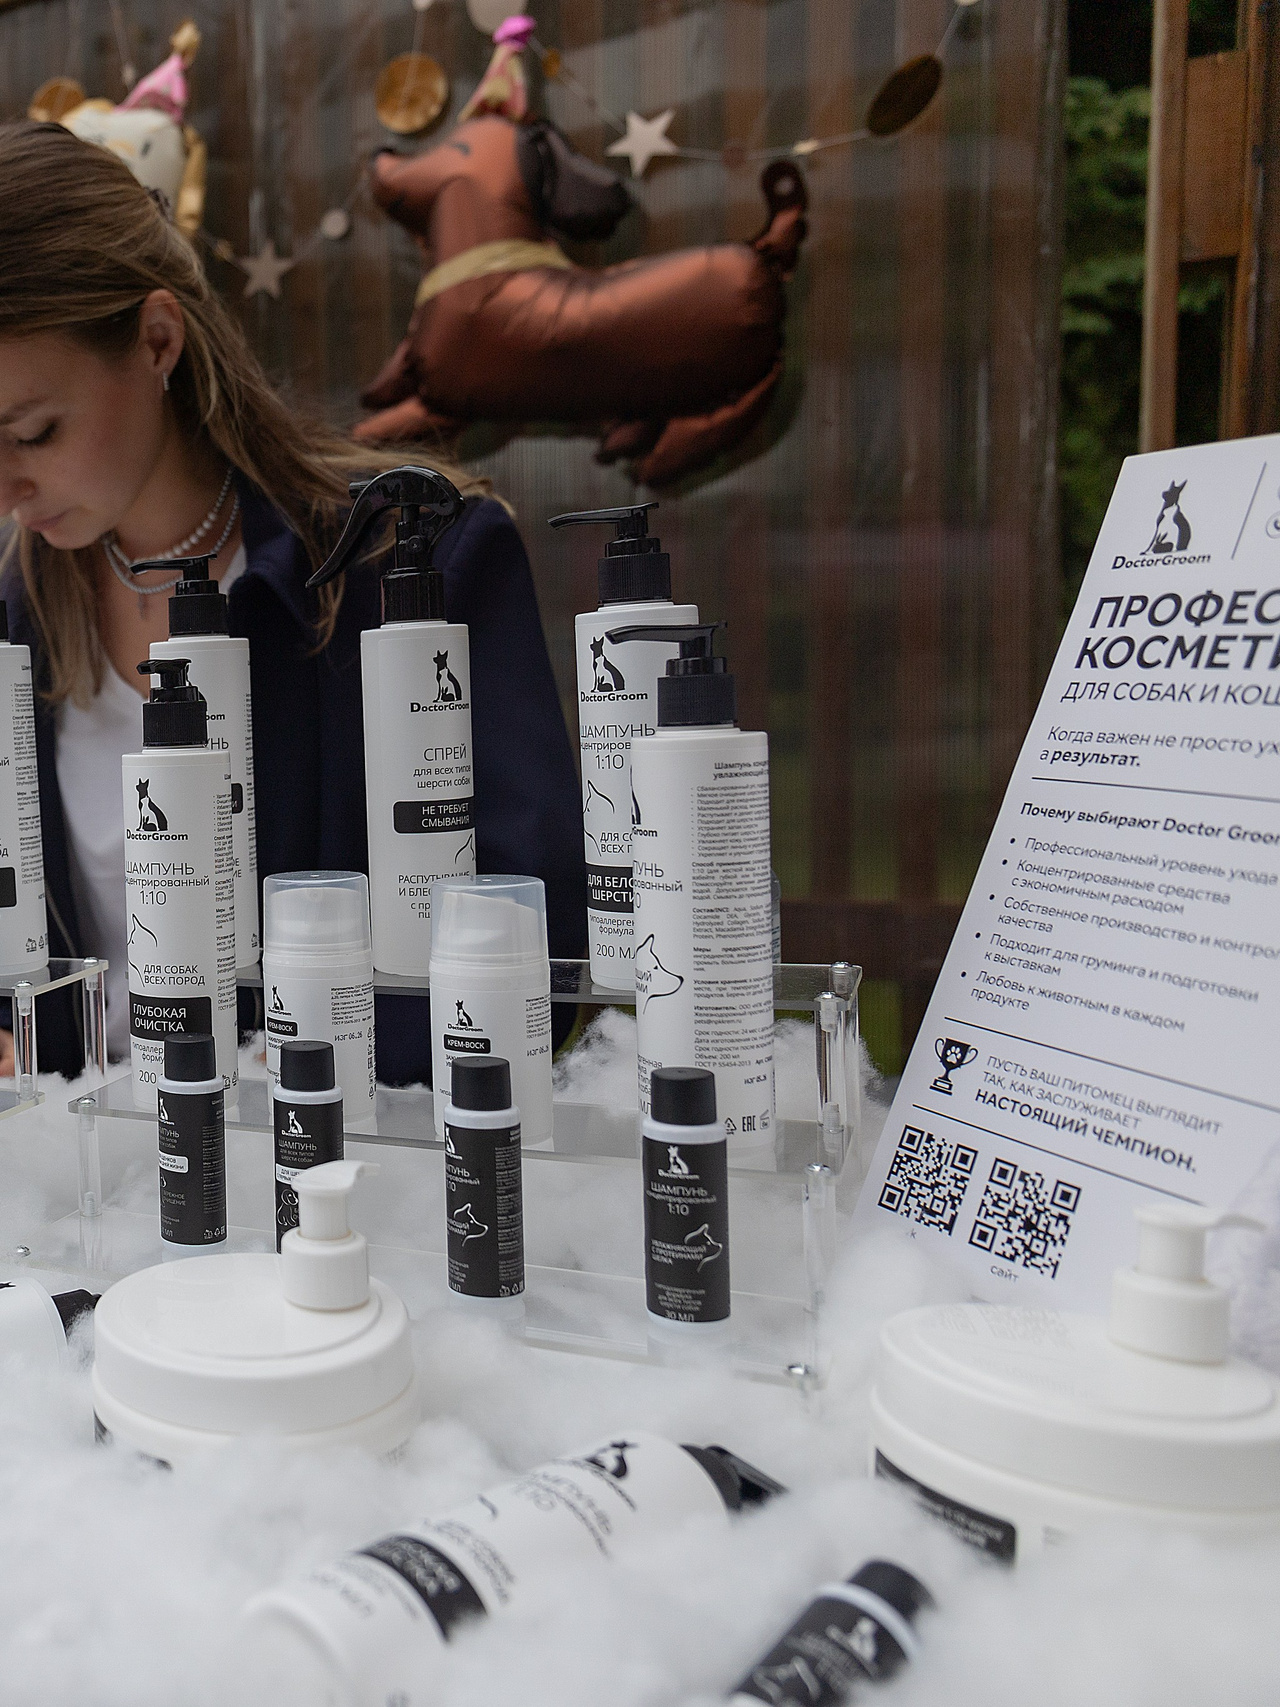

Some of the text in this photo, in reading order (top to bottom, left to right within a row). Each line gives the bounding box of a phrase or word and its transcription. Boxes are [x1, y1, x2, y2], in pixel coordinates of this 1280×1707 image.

[1111, 554, 1211, 570] DoctorGroom
[1089, 587, 1280, 628] ПРОФЕС
[1060, 682, 1110, 703] ДЛЯ
[1113, 682, 1196, 702] СОБАК
[1199, 684, 1220, 703] И
[1047, 726, 1093, 744] Когда
[1096, 732, 1151, 746] важен
[1153, 734, 1177, 748] не
[1180, 736, 1252, 753] просто
[423, 743, 466, 761] СПРЕЙ
[1039, 749, 1140, 767] а результат.
[595, 754, 624, 769] 1:10
[413, 768, 432, 777] для
[434, 767, 454, 775] всех
[417, 780, 452, 790] шерсти
[422, 803, 469, 815] НЕ ТРЕБУЕТ
[422, 815, 470, 828] СМЫВАНИЯ
[1020, 802, 1076, 823] Почему
[1077, 811, 1161, 830] выбирают
[1163, 818, 1224, 838] Doctor
[126, 829, 188, 841] DoctorGroom
[600, 832, 619, 842] ДЛЯ
[601, 844, 625, 853] ВСЕХ
[1024, 837, 1279, 886] Профессиональный уровень ухода
[1016, 859, 1231, 905] Концентрированные средства
[139, 890, 167, 905] 1:10
[399, 888, 406, 896] И
[1011, 877, 1185, 915] с экономичным расходом
[997, 914, 1053, 933] качества
[1003, 896, 1089, 923] Собственное
[1090, 915, 1197, 943] производство
[1200, 934, 1211, 946] и
[598, 925, 634, 937] формула
[596, 944, 614, 958] 200
[143, 964, 199, 974] ДЛЯ СОБАК
[984, 951, 1061, 976] к выставкам
[990, 933, 1259, 1002] Подходит для груминга и подготовки
[144, 975, 206, 986] ВСЕХ ПОРОД
[970, 988, 1030, 1011] продукте
[976, 970, 1185, 1032] Любовь к животным в каждом
[133, 1003, 187, 1019] ГЛУБОКАЯ
[134, 1017, 185, 1032] ОЧИСТКА
[447, 1039, 485, 1050] КРЕМ-ВОСК
[139, 1070, 157, 1084] 200
[982, 1071, 1141, 1129] ТАК, КАК ЗАСЛУЖИВАЕТ
[987, 1056, 1222, 1135] ПУСТЬ ВАШ ПИТОМЕЦ ВЫГЛЯДИТ
[975, 1088, 1196, 1174] НАСТОЯЩИЙ ЧЕМПИОН.
[278, 1139, 317, 1151] ШАМПУНЬ
[650, 1181, 708, 1197] ШАМПУНЬ
[667, 1203, 690, 1216] 1:10
[990, 1265, 1019, 1282] сайт
